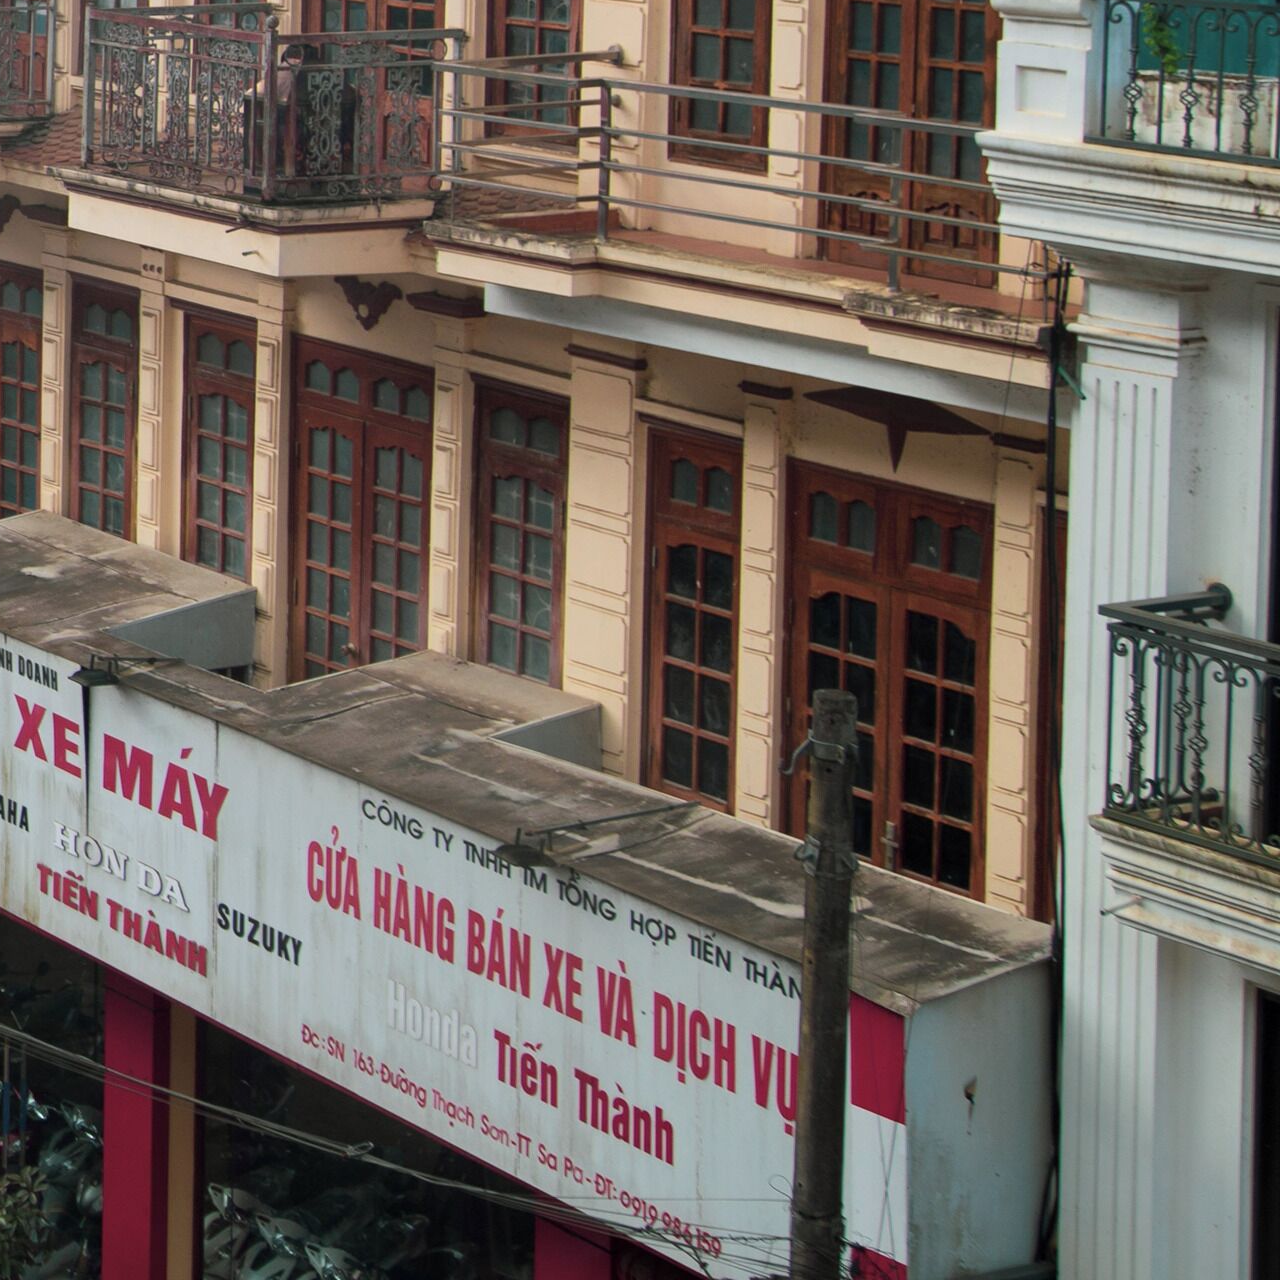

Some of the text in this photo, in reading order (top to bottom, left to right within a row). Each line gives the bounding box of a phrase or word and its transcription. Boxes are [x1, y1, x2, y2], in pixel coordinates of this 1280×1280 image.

[18, 655, 58, 692] DOANH
[13, 693, 229, 842] XE MÁY
[37, 863, 207, 978] TIẾN THÀNH
[53, 821, 190, 912] HON DA
[361, 799, 803, 1001] CÔNG TY TNHH TM TỔNG HỢP TIẾN THÀN
[217, 902, 302, 966] SUZUKY
[306, 825, 799, 1136] CỬA HÀNG BÁN XE VÀ DỊCH VỤ
[386, 979, 675, 1166] Honda Tiến Thành
[432, 1087, 475, 1128] Thạch
[538, 1144, 558, 1173] Sa
